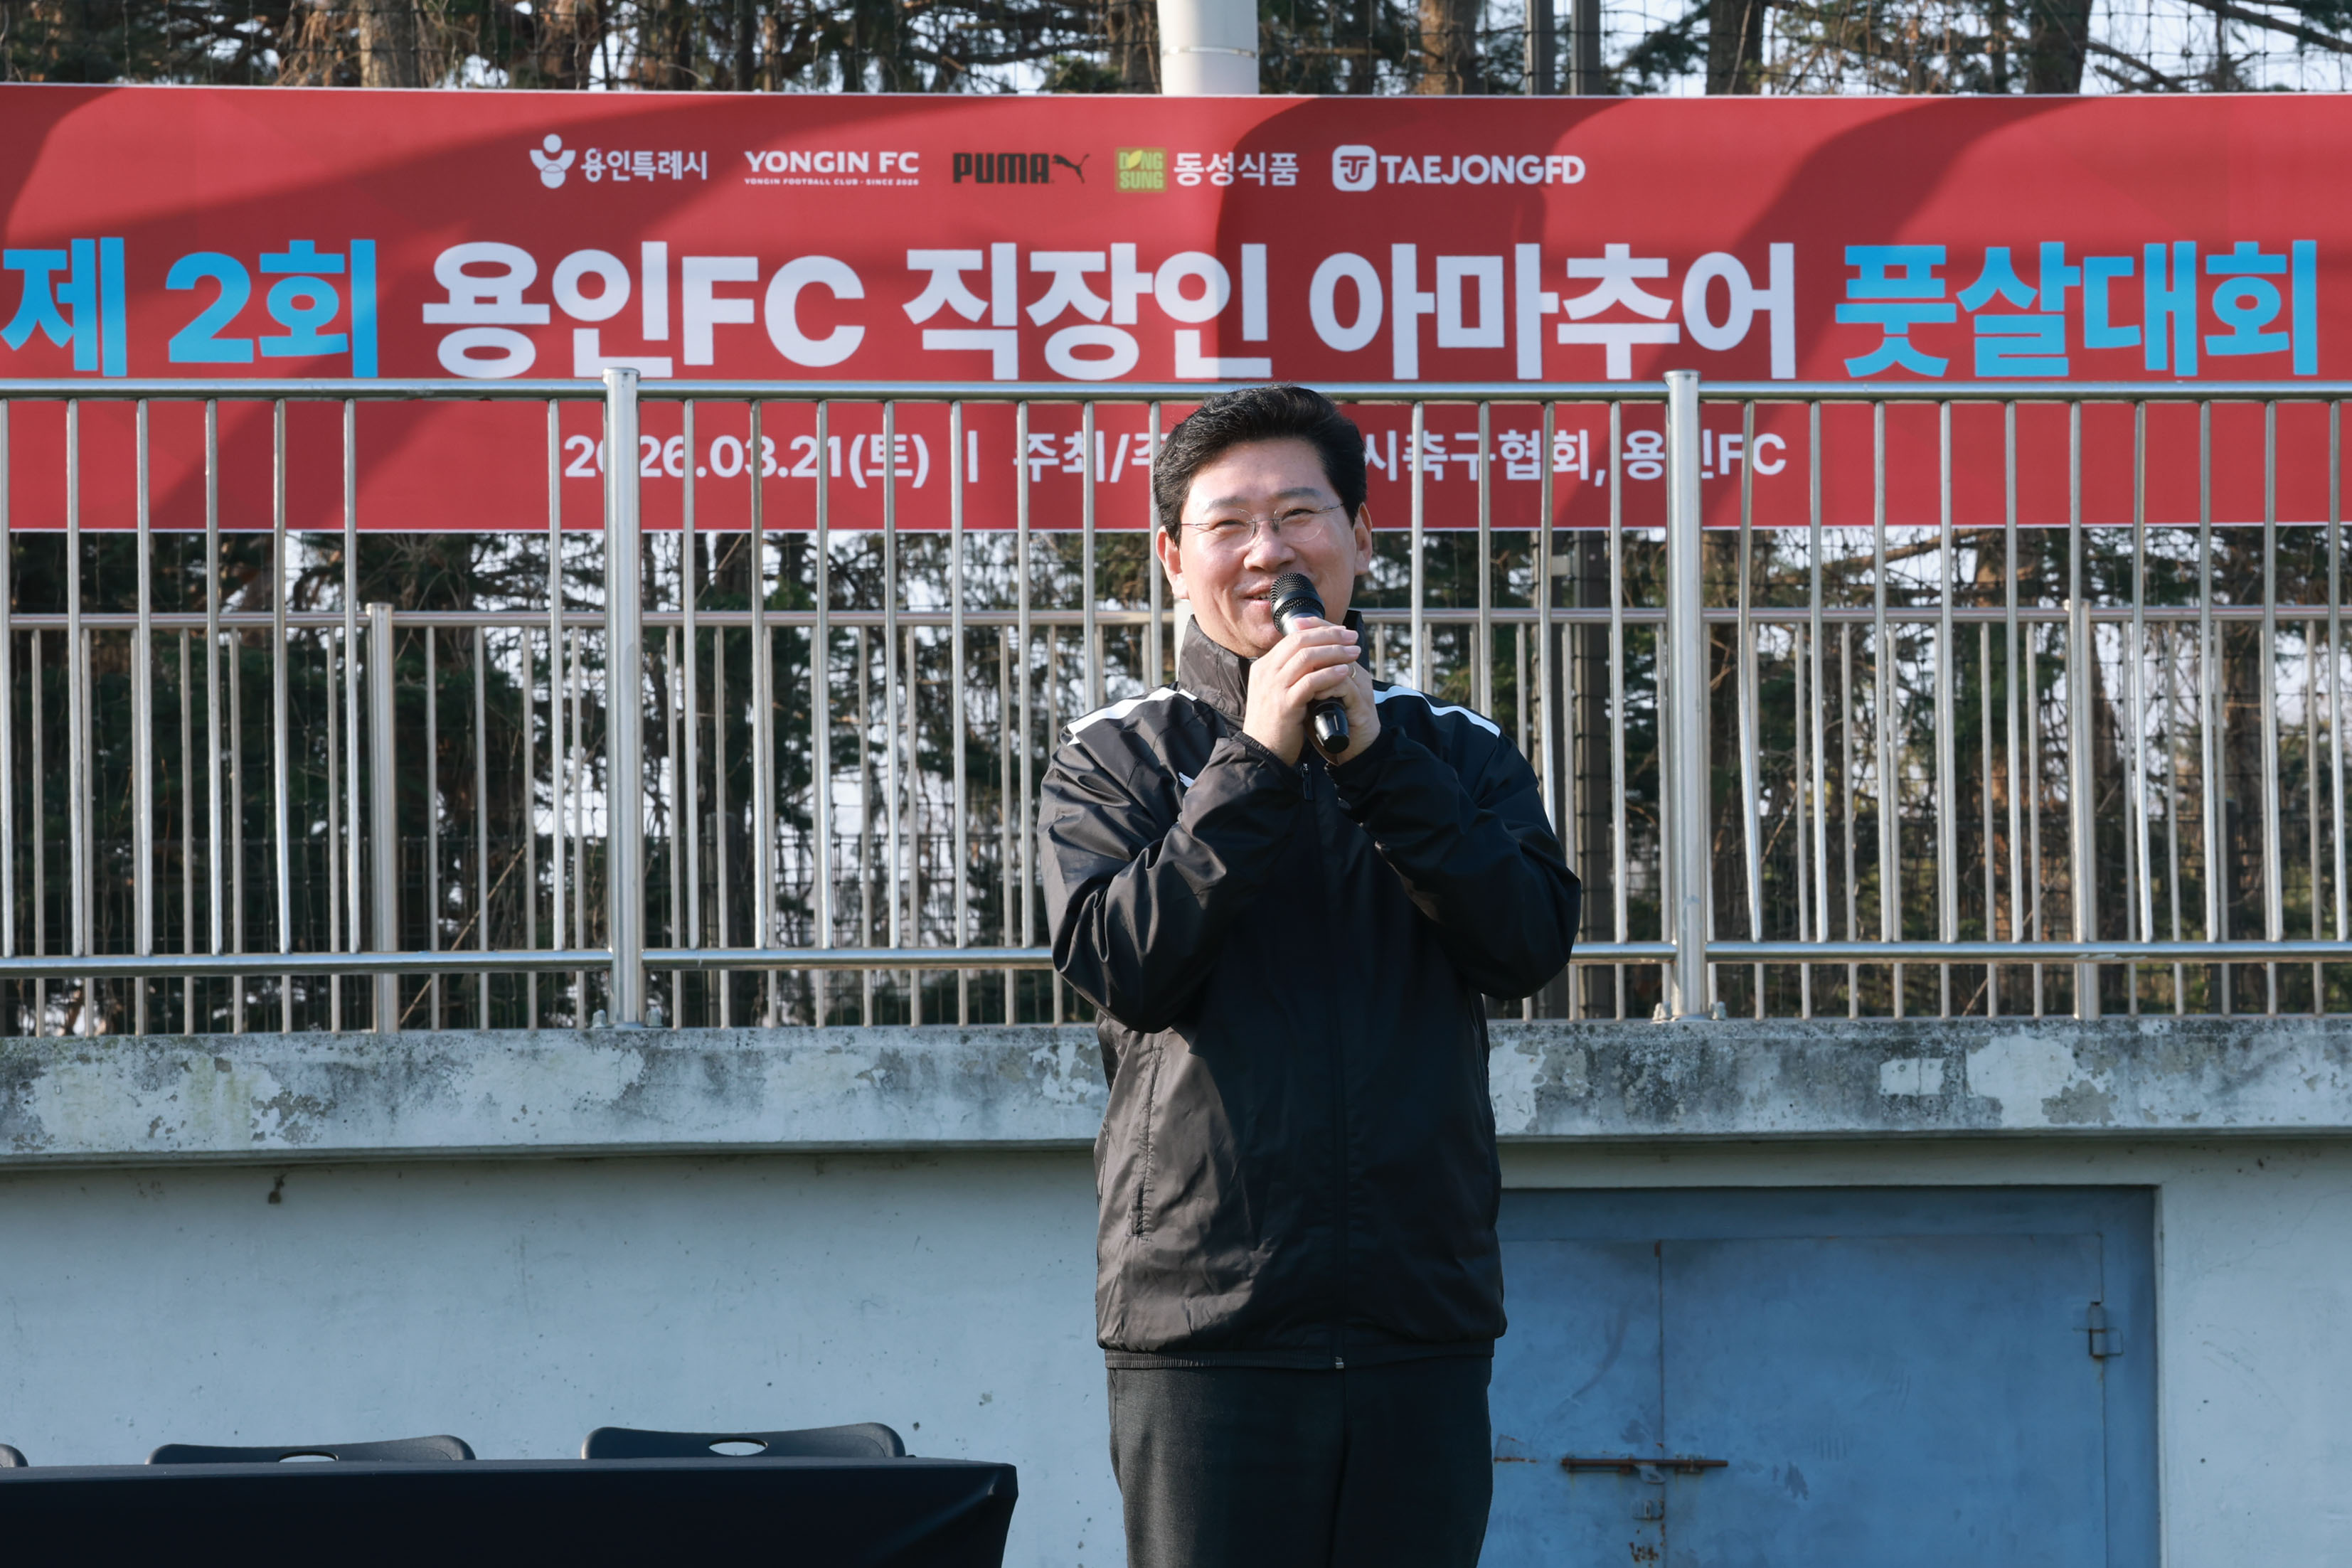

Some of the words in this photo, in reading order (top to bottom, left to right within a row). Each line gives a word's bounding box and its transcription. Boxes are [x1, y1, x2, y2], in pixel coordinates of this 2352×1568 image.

[580, 147, 708, 183] 용인특례시
[744, 150, 869, 174] YONGIN
[878, 151, 920, 174] FC
[953, 152, 1050, 184] PUMA
[1119, 150, 1164, 170] DNG
[1174, 151, 1299, 186] 동성식품
[1380, 154, 1586, 185] TAEJONGFD
[783, 178, 831, 186] FOOTBALL
[833, 178, 858, 186] CLUB
[866, 178, 893, 186] SINCE
[1119, 171, 1164, 189] SUNG
[0, 236, 127, 377] 제
[165, 239, 378, 378] 2회
[422, 240, 866, 378] 용인FC
[902, 242, 1272, 380] 직장인
[1309, 242, 1797, 380] 아마추어
[1835, 239, 2318, 378] 풋살대회
[564, 434, 930, 489] 226.03.21(토)
